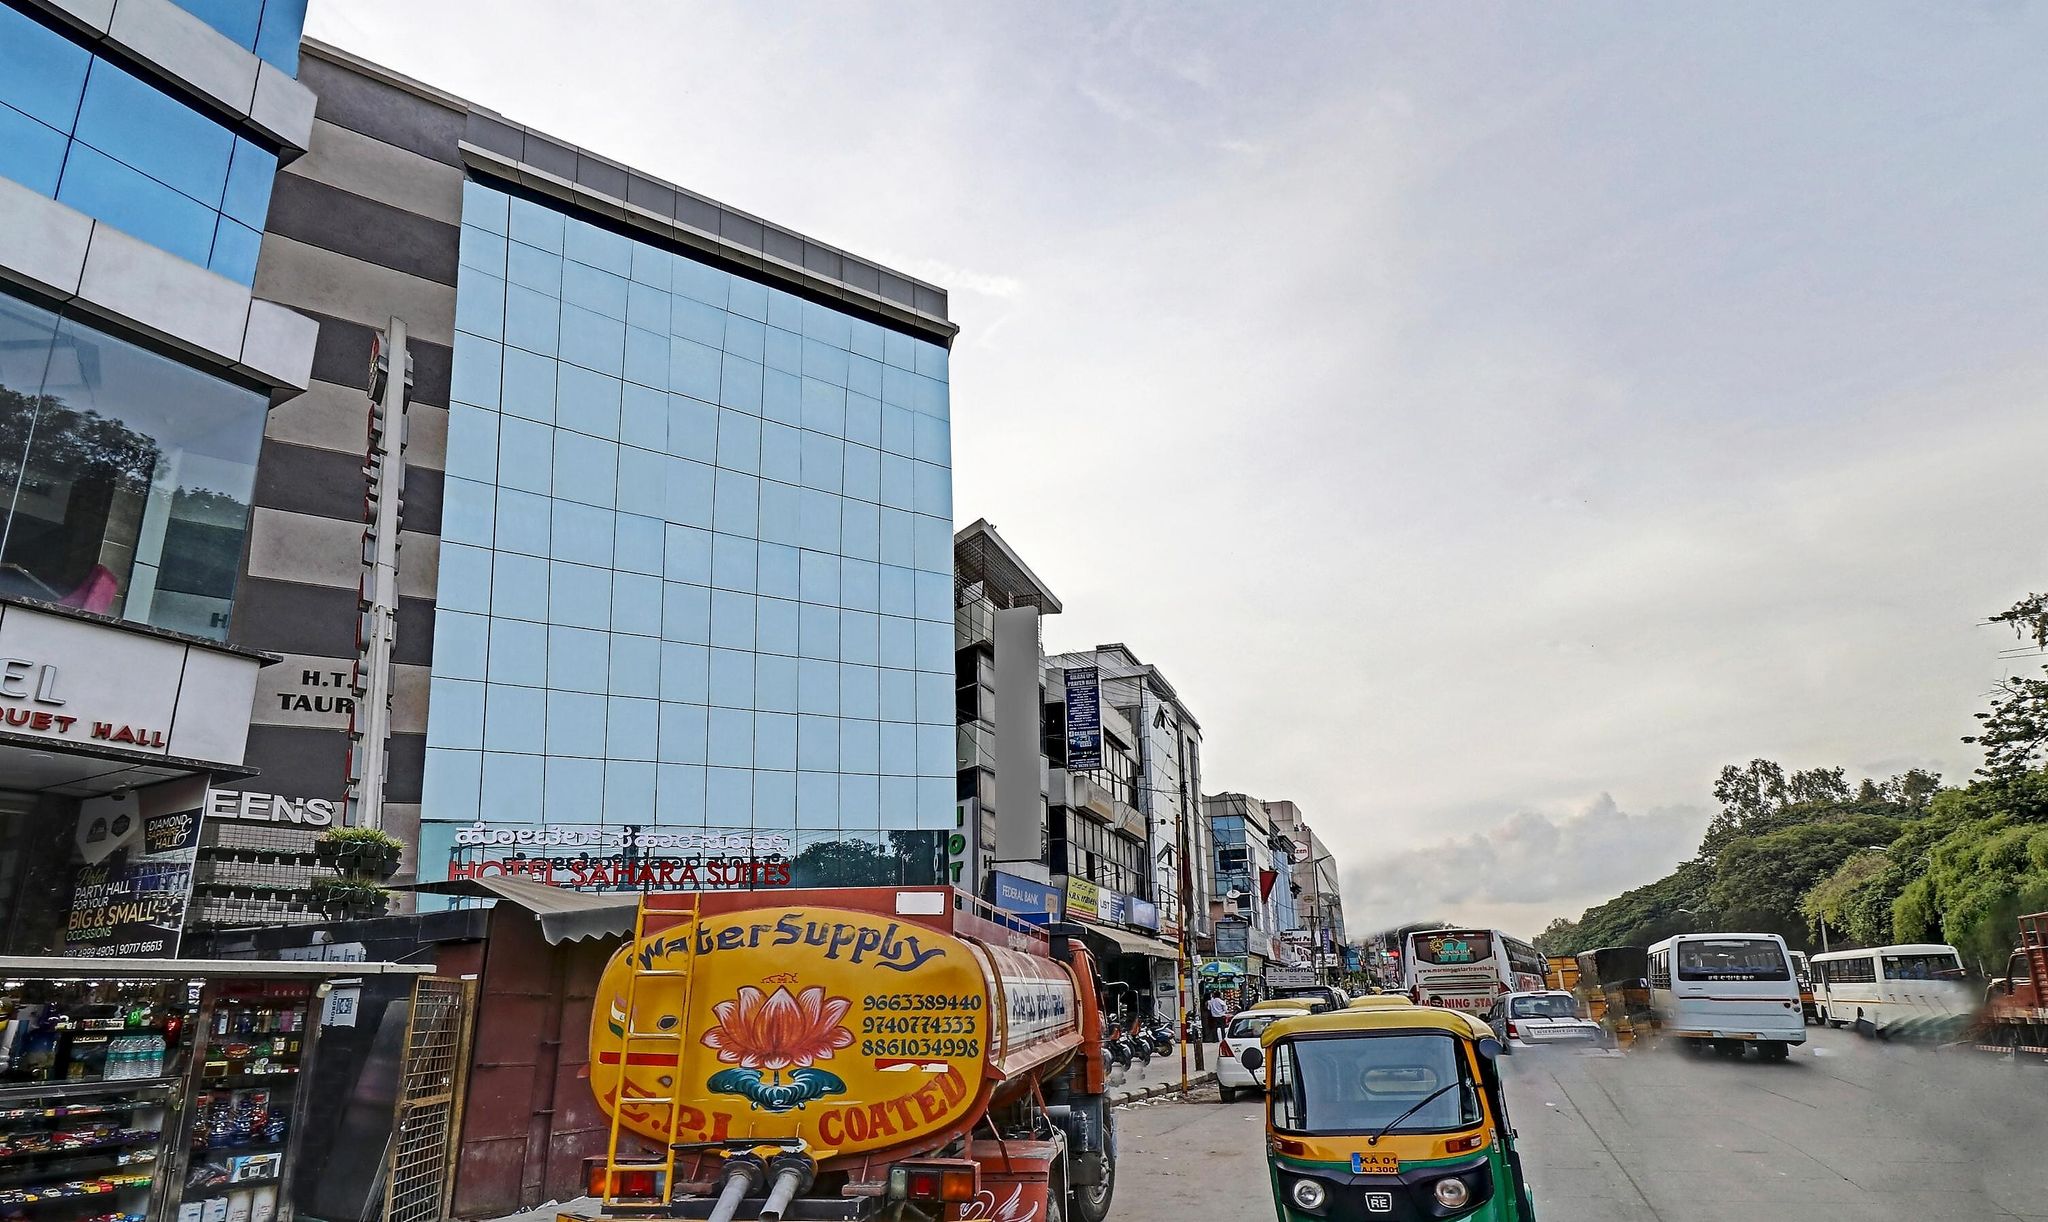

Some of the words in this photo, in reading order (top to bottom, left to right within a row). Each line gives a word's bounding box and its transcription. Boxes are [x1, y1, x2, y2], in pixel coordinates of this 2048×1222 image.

[0, 706, 77, 733] UET
[91, 721, 165, 748] HALL
[149, 814, 188, 831] DIAMOND
[570, 860, 701, 888] SAHARA
[706, 861, 791, 887] SUITES
[75, 883, 106, 900] PARTY
[105, 880, 131, 896] HALL
[1002, 884, 1024, 902] FEDERAL
[1024, 890, 1039, 906] BANK
[72, 900, 89, 911] FOR
[88, 896, 109, 909] YOUR
[68, 908, 93, 930] BIG
[93, 907, 105, 928] &
[106, 900, 155, 926] SMALL
[66, 927, 112, 942] OCCASSIONS
[772, 913, 946, 972] Supply
[96, 945, 116, 957] 4905
[119, 942, 141, 955] 90717
[140, 940, 164, 953] 66613
[863, 994, 981, 1011] 9663389440
[862, 1016, 976, 1034] 9740774333
[862, 1038, 979, 1058] 8861034998
[818, 1065, 966, 1146] COATED
[1360, 1157, 1378, 1165] KA
[1383, 1157, 1398, 1165] 01
[1370, 1198, 1388, 1208] RE
